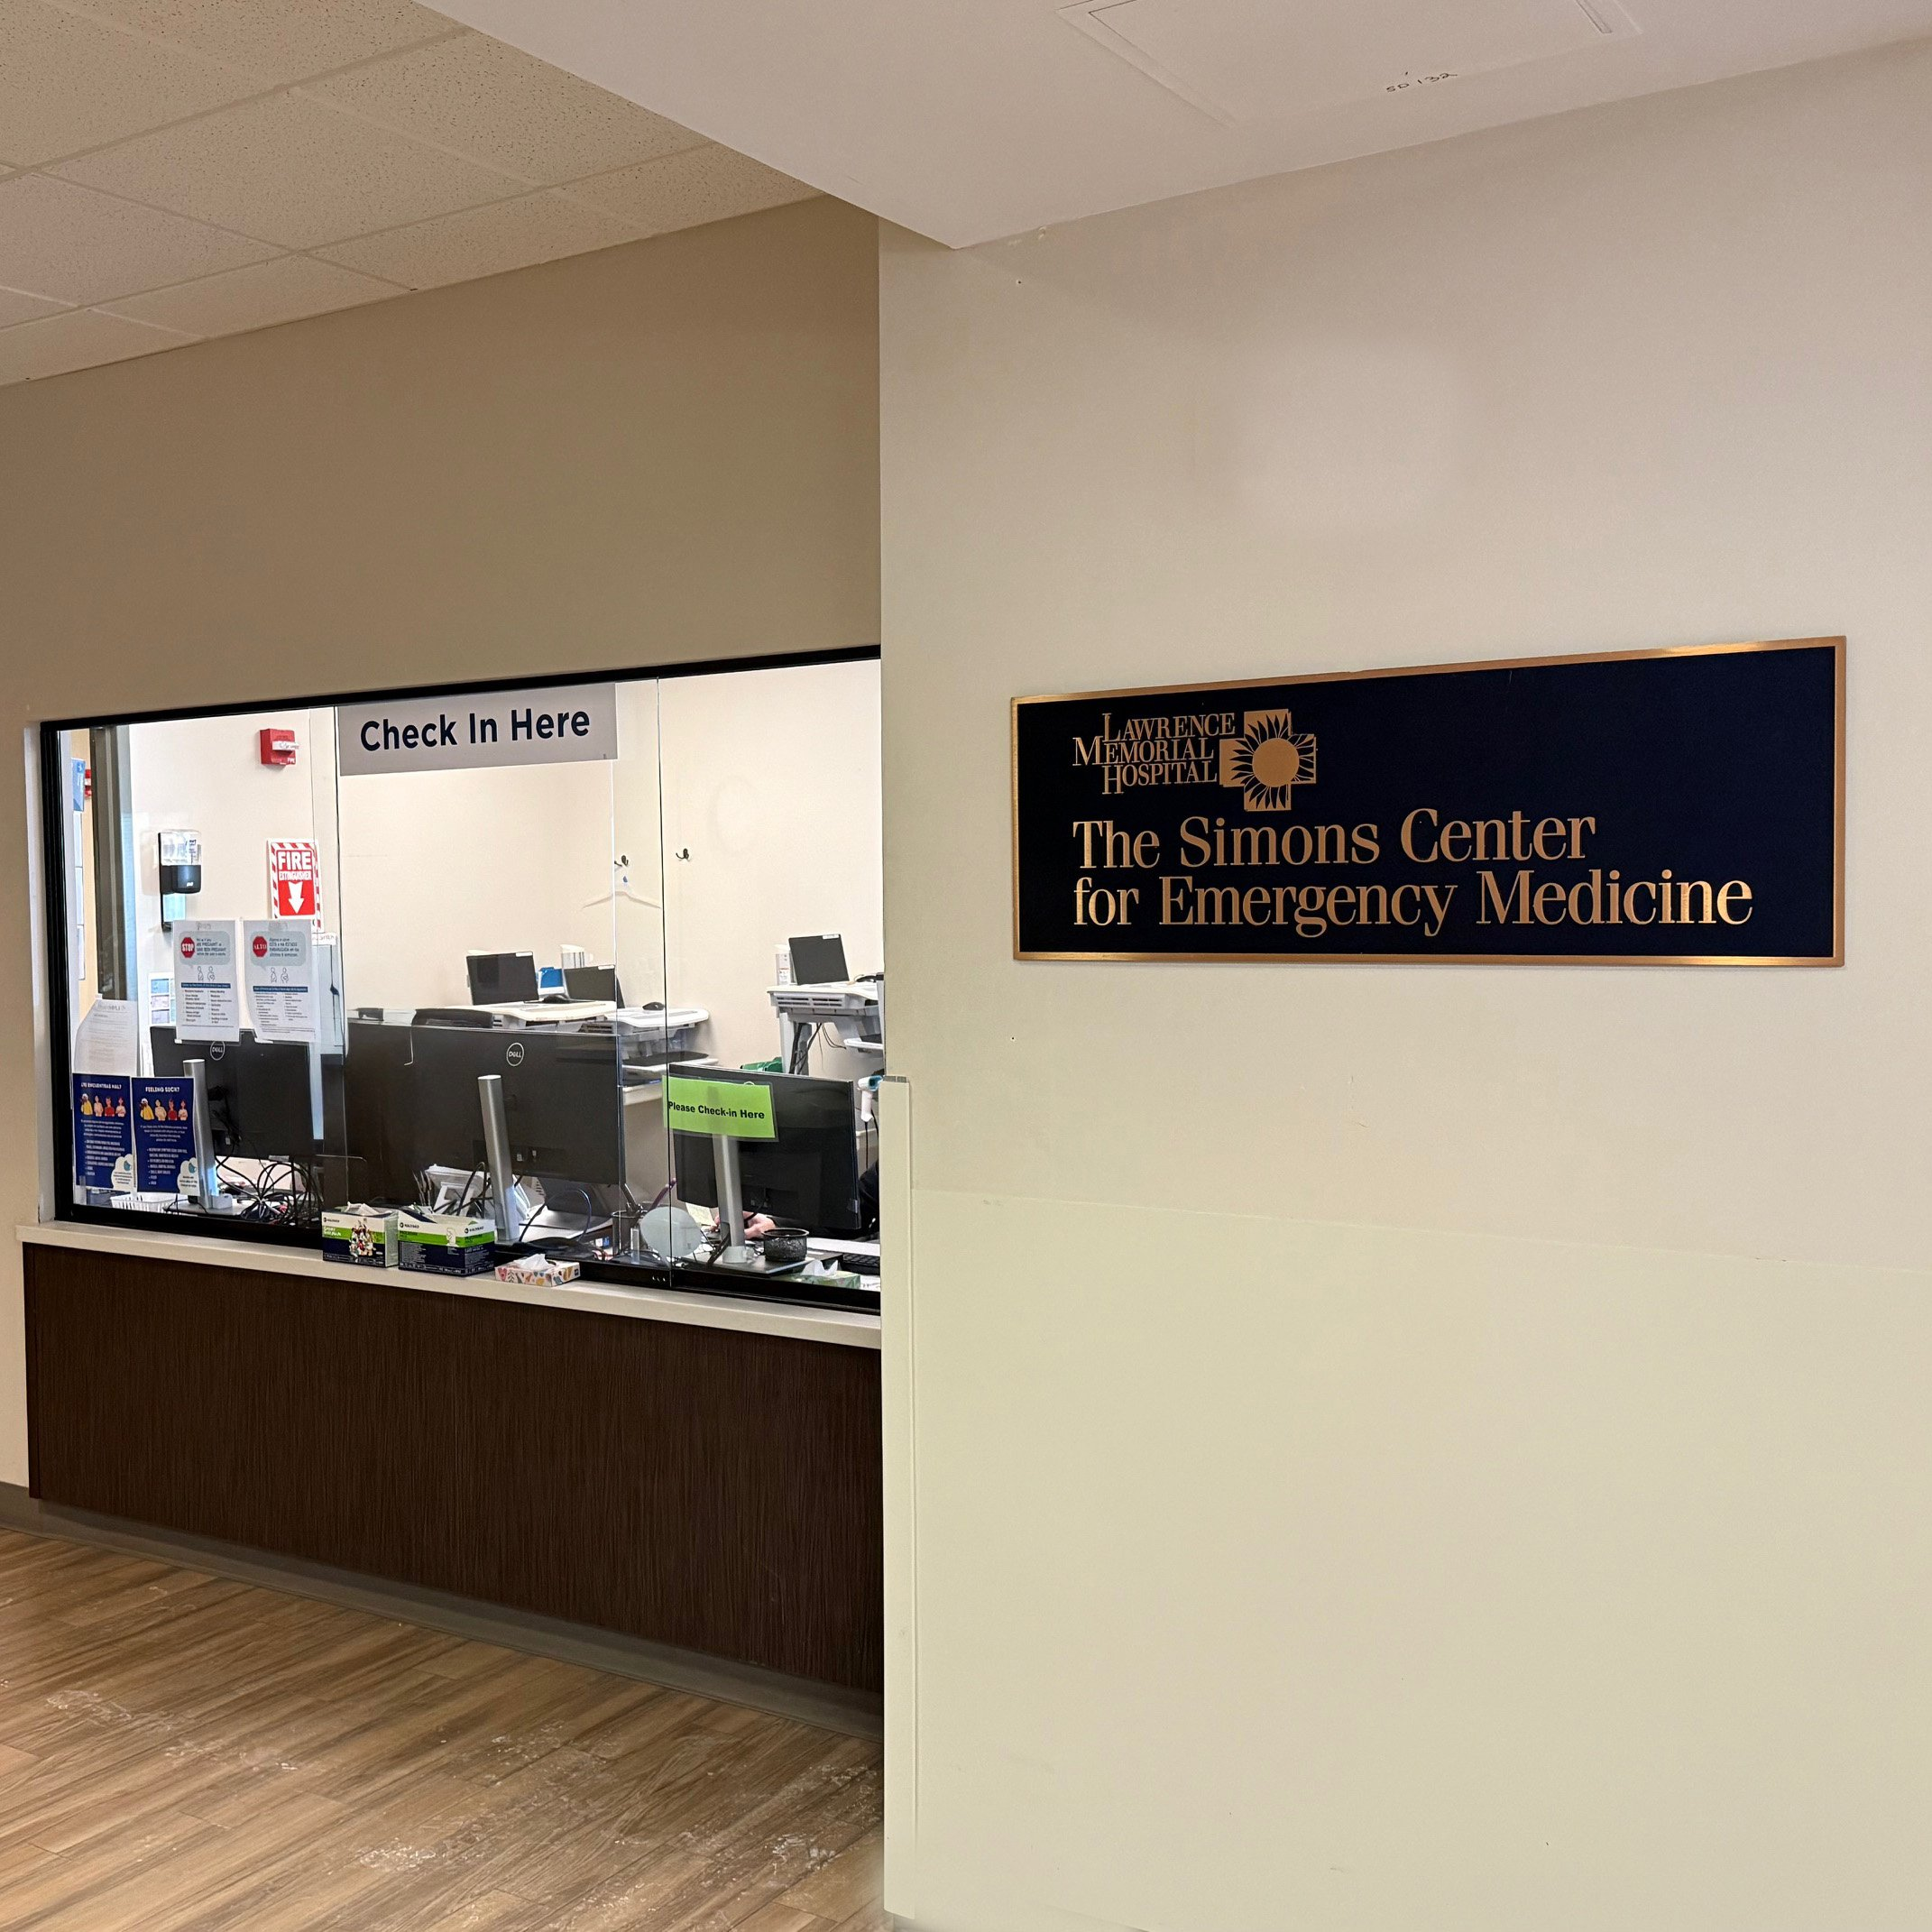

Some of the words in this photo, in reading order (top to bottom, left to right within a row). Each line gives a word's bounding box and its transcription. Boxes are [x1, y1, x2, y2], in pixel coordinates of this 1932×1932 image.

[361, 713, 457, 752] Check
[469, 713, 498, 744] In
[511, 708, 591, 741] Here
[1101, 712, 1237, 743] LAWRENCE
[1072, 735, 1215, 767] MEMORIAL
[1101, 759, 1219, 795] HOSPITAL
[1072, 820, 1161, 869] The
[1179, 816, 1381, 868] Simons
[1400, 807, 1596, 863] Center
[277, 851, 312, 870] FIRE
[1072, 877, 1140, 926] for
[1158, 875, 1458, 938] Emergency
[1476, 869, 1753, 926] Medicine
[181, 943, 195, 952] STOP
[508, 1050, 522, 1059] DELL
[668, 1100, 695, 1113] Please
[698, 1105, 738, 1118] Check-in
[741, 1109, 766, 1119] Here
